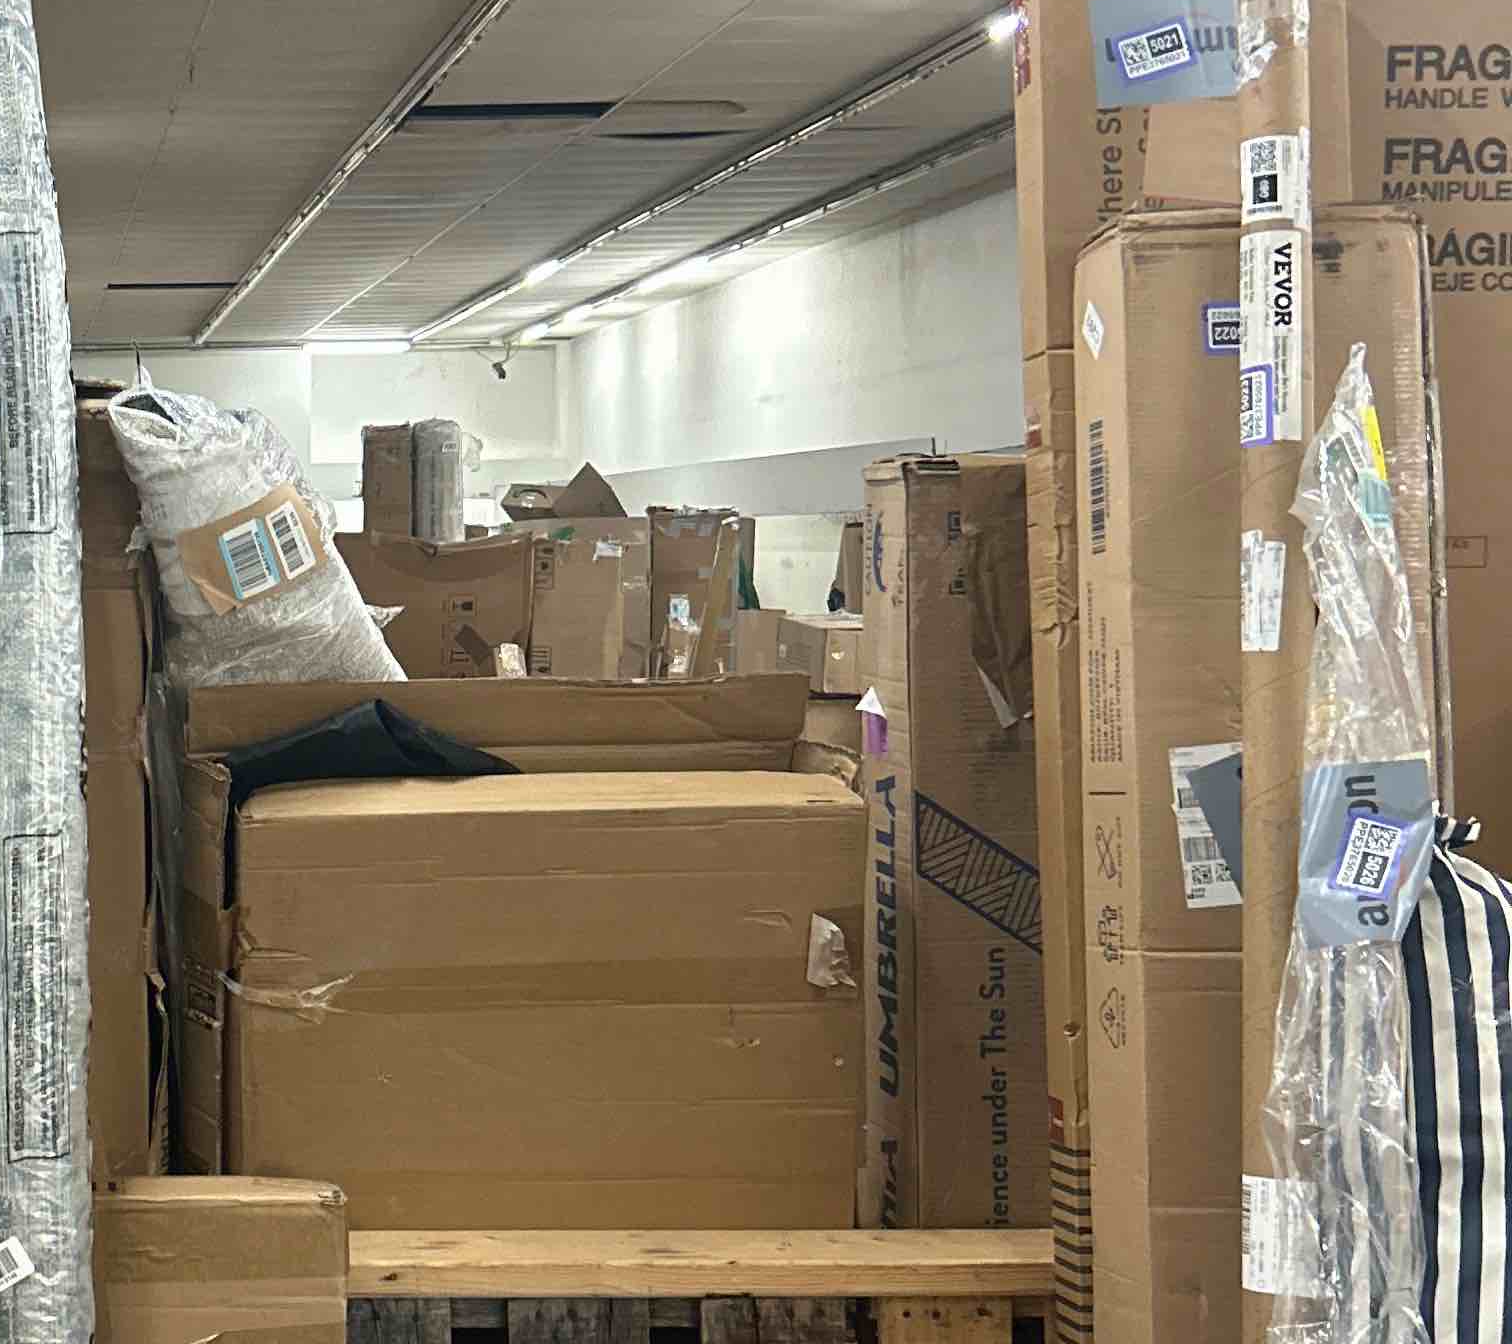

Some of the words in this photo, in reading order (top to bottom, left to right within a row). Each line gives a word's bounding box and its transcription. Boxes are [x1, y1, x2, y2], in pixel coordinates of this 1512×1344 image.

[1149, 34, 1180, 56] 5021
[1385, 88, 1489, 109] HANDLE
[1274, 242, 1292, 327] VEVOR
[1359, 854, 1383, 886] 5026
[878, 774, 899, 1098] UMBRELLA
[978, 947, 1006, 1000] Sun
[979, 1007, 1008, 1059] The
[982, 1067, 1008, 1145] under
